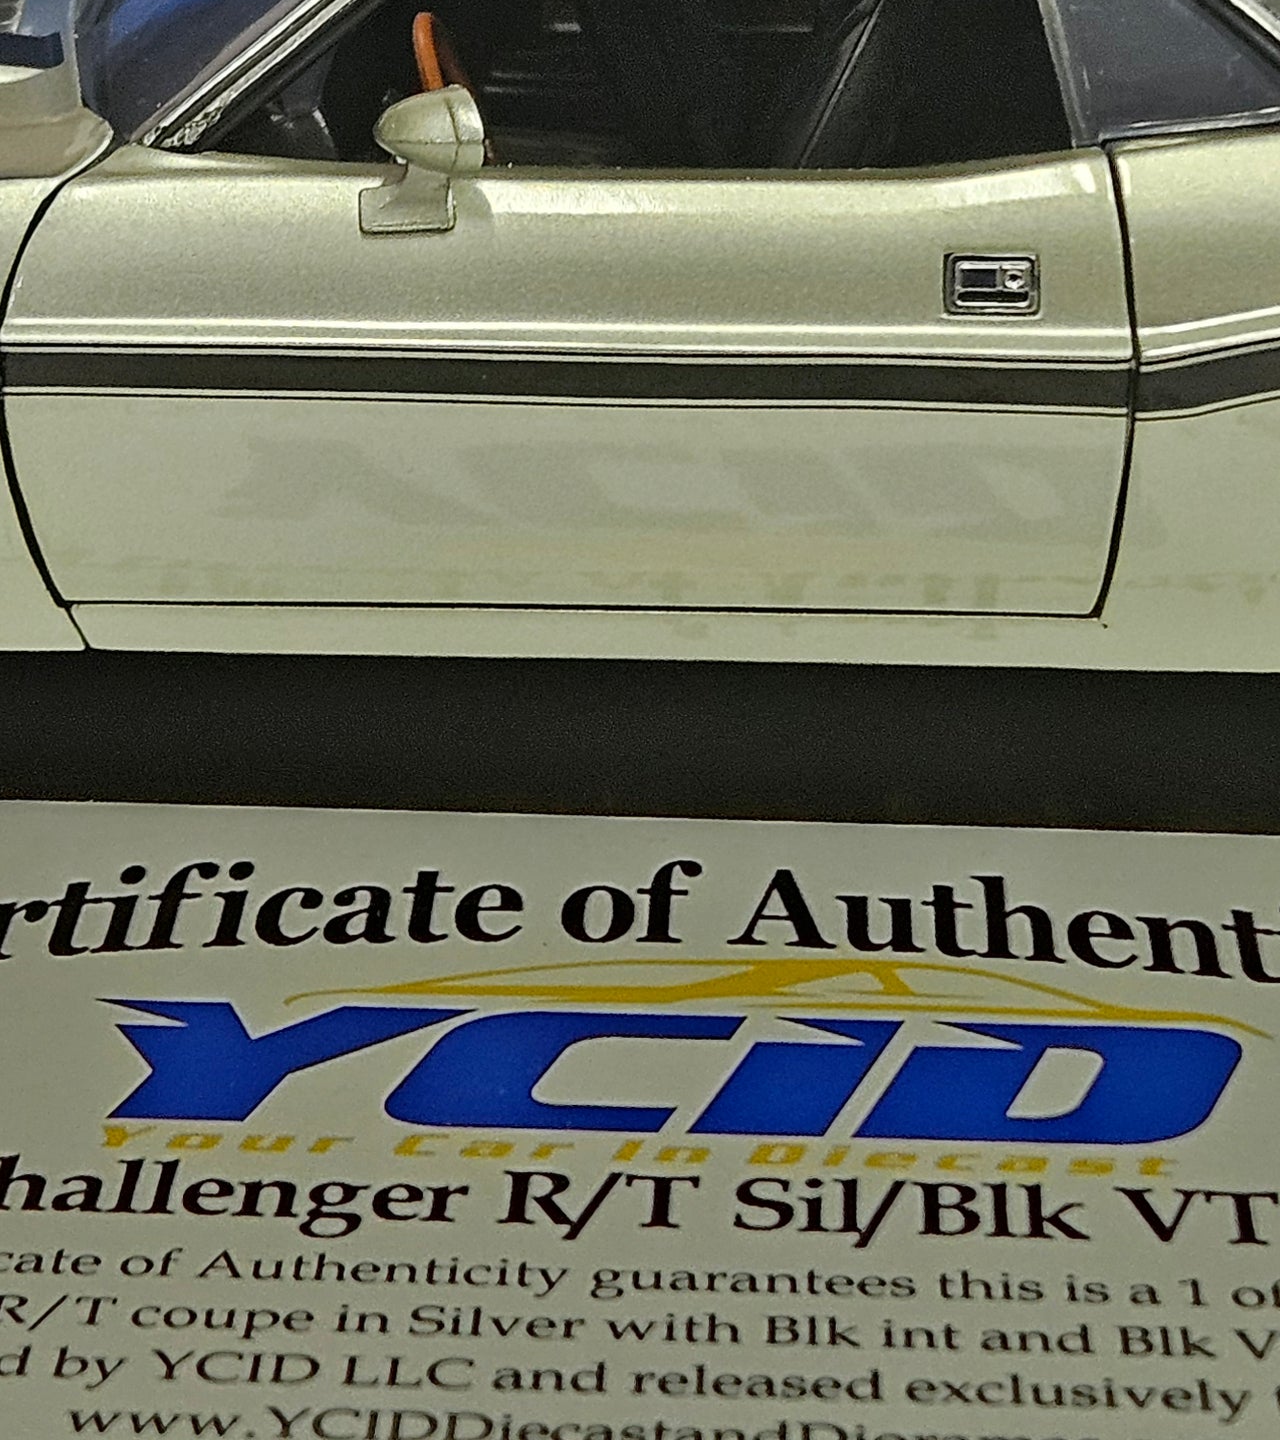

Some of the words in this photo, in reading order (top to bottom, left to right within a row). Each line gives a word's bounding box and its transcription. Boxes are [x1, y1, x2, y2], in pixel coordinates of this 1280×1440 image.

[560, 859, 704, 947] of
[101, 1125, 356, 1154] Your
[392, 1133, 575, 1160] Car
[747, 1143, 1176, 1178] Diecast
[495, 1169, 702, 1241] R/T
[731, 1177, 1091, 1248] Sil/Blk
[1113, 1187, 1280, 1247] VT
[120, 1247, 184, 1278] of
[198, 1249, 569, 1298] Authenticity
[590, 1266, 917, 1300] guarantees
[938, 1269, 1045, 1303] this
[1066, 1273, 1110, 1304] is
[1129, 1282, 1161, 1306] a
[1178, 1278, 1208, 1307] 1
[130, 1304, 316, 1340] coupe
[335, 1305, 390, 1335] in
[408, 1305, 585, 1341] Silver
[605, 1312, 740, 1344] with
[765, 1315, 862, 1349] Blk
[882, 1318, 961, 1351] int
[980, 1322, 1095, 1355] and
[1119, 1325, 1217, 1360] Blk
[53, 1345, 127, 1391] by
[152, 1348, 321, 1385] YCID
[342, 1355, 476, 1391] LLC
[493, 1361, 608, 1394] and
[631, 1363, 884, 1404] released
[905, 1372, 1251, 1426] exclusively
